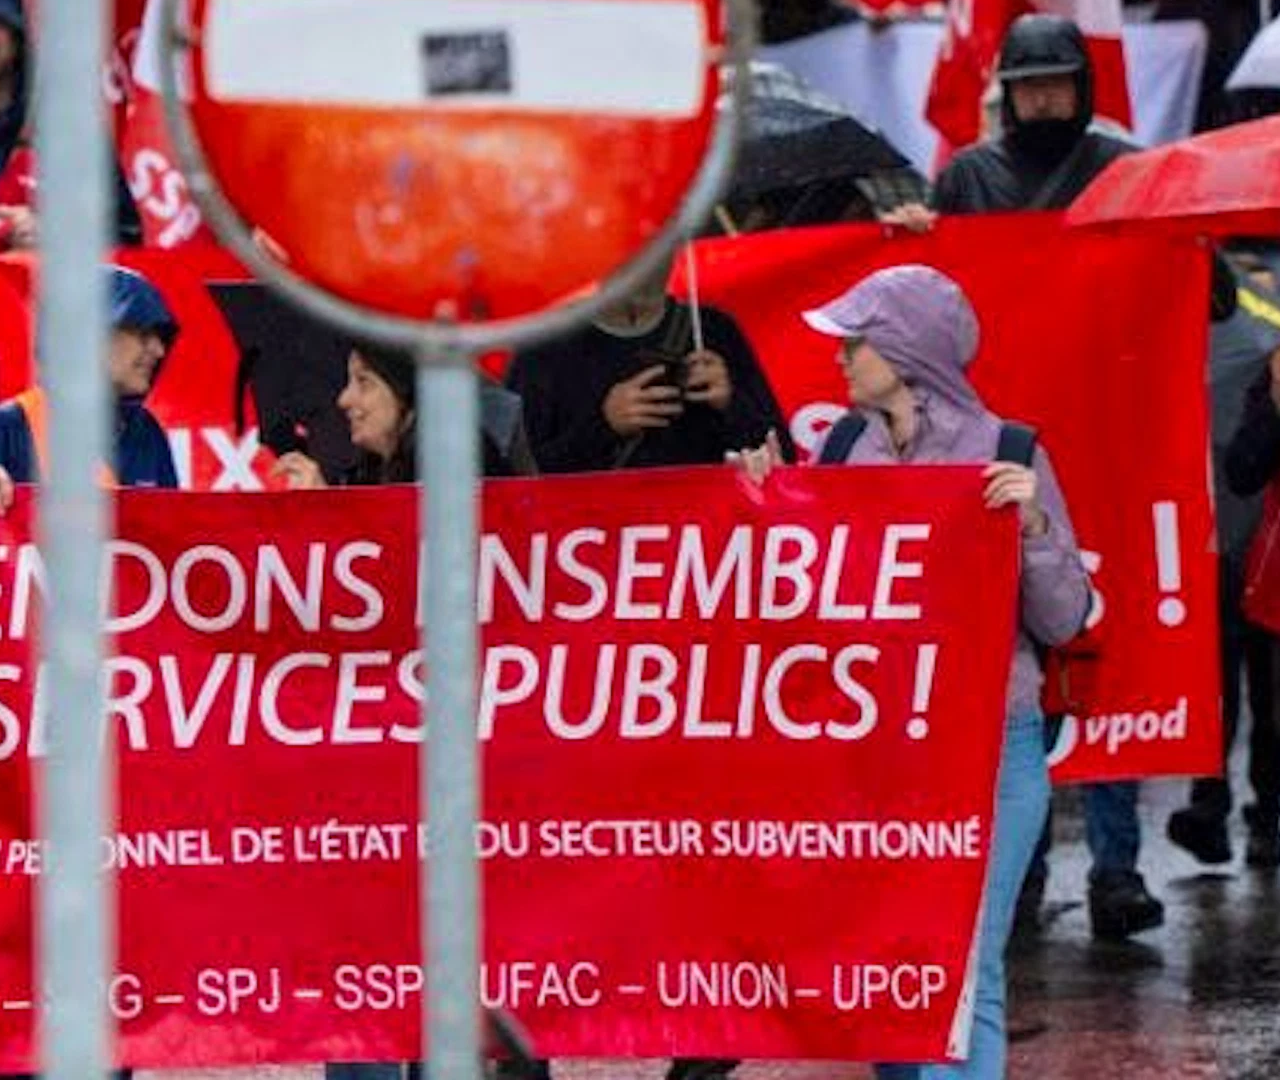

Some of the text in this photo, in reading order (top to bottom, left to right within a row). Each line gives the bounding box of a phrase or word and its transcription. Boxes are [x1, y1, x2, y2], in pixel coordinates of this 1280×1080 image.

[415, 523, 931, 626] NSEMBLE
[477, 643, 881, 740] PUBLICS
[1085, 696, 1188, 755] vpod
[231, 827, 285, 863] DE
[477, 820, 529, 859] DU
[540, 820, 705, 858] SECTEUR
[712, 815, 980, 859] SUBVENTIONNÉ
[197, 968, 282, 1016] SPJ
[333, 964, 425, 1011] SSP
[479, 961, 601, 1009] UFAC
[657, 961, 790, 1008] UNION
[833, 963, 949, 1010] UPCP
